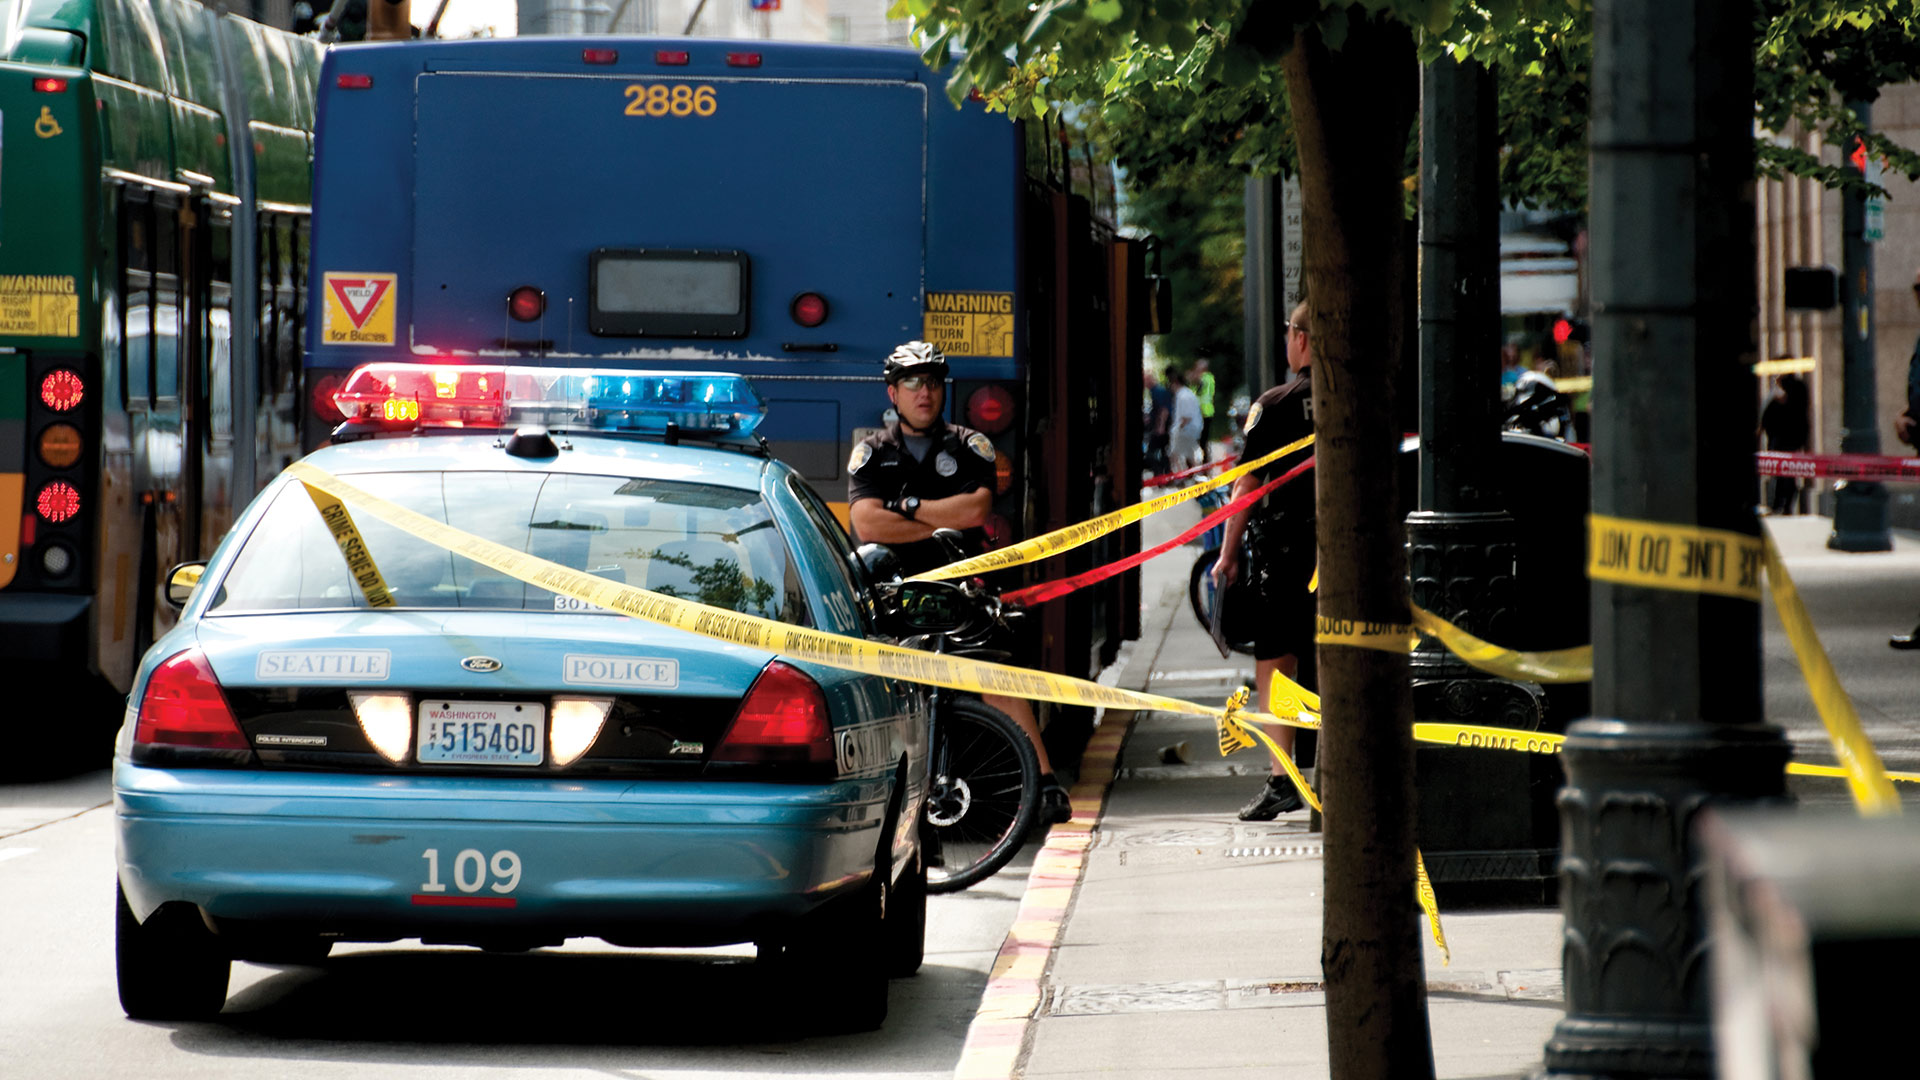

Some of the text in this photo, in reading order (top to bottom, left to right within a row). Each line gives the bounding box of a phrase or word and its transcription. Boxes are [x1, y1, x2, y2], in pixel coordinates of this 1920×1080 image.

[624, 84, 717, 116] 2886
[1286, 267, 1299, 279] 27
[0, 275, 76, 293] WARNING
[347, 289, 371, 297] YIELD
[927, 293, 1012, 313] WARNING
[931, 315, 966, 326] RIGHT
[332, 331, 346, 341] for
[933, 328, 964, 339] TURN
[935, 341, 970, 353] AZARD
[1781, 460, 1816, 477] CROSS
[322, 504, 353, 540] CRIME
[346, 537, 372, 573] SCENE
[1599, 529, 1631, 570] NOT
[1638, 536, 1671, 576] DO
[1679, 537, 1726, 582] LINE
[358, 571, 379, 588] DO
[367, 587, 391, 608] NOT
[556, 598, 604, 610] 301
[823, 590, 856, 632] 109
[695, 611, 715, 635] CRIME
[710, 614, 729, 639] SCENE
[744, 621, 763, 647] CROSS
[785, 631, 802, 656] CRIME
[802, 634, 818, 660] SCENE
[837, 641, 853, 666] CROSS
[264, 655, 380, 673] SEATTLE
[469, 659, 493, 669] Ford
[572, 659, 669, 682] POLICE
[429, 711, 496, 720] WASHINGTON
[441, 722, 536, 754] 51546D
[856, 724, 898, 768] SEATTLE
[1457, 731, 1520, 750] CRIME
[452, 753, 488, 761] EVERGREEN
[422, 848, 522, 894] 109
